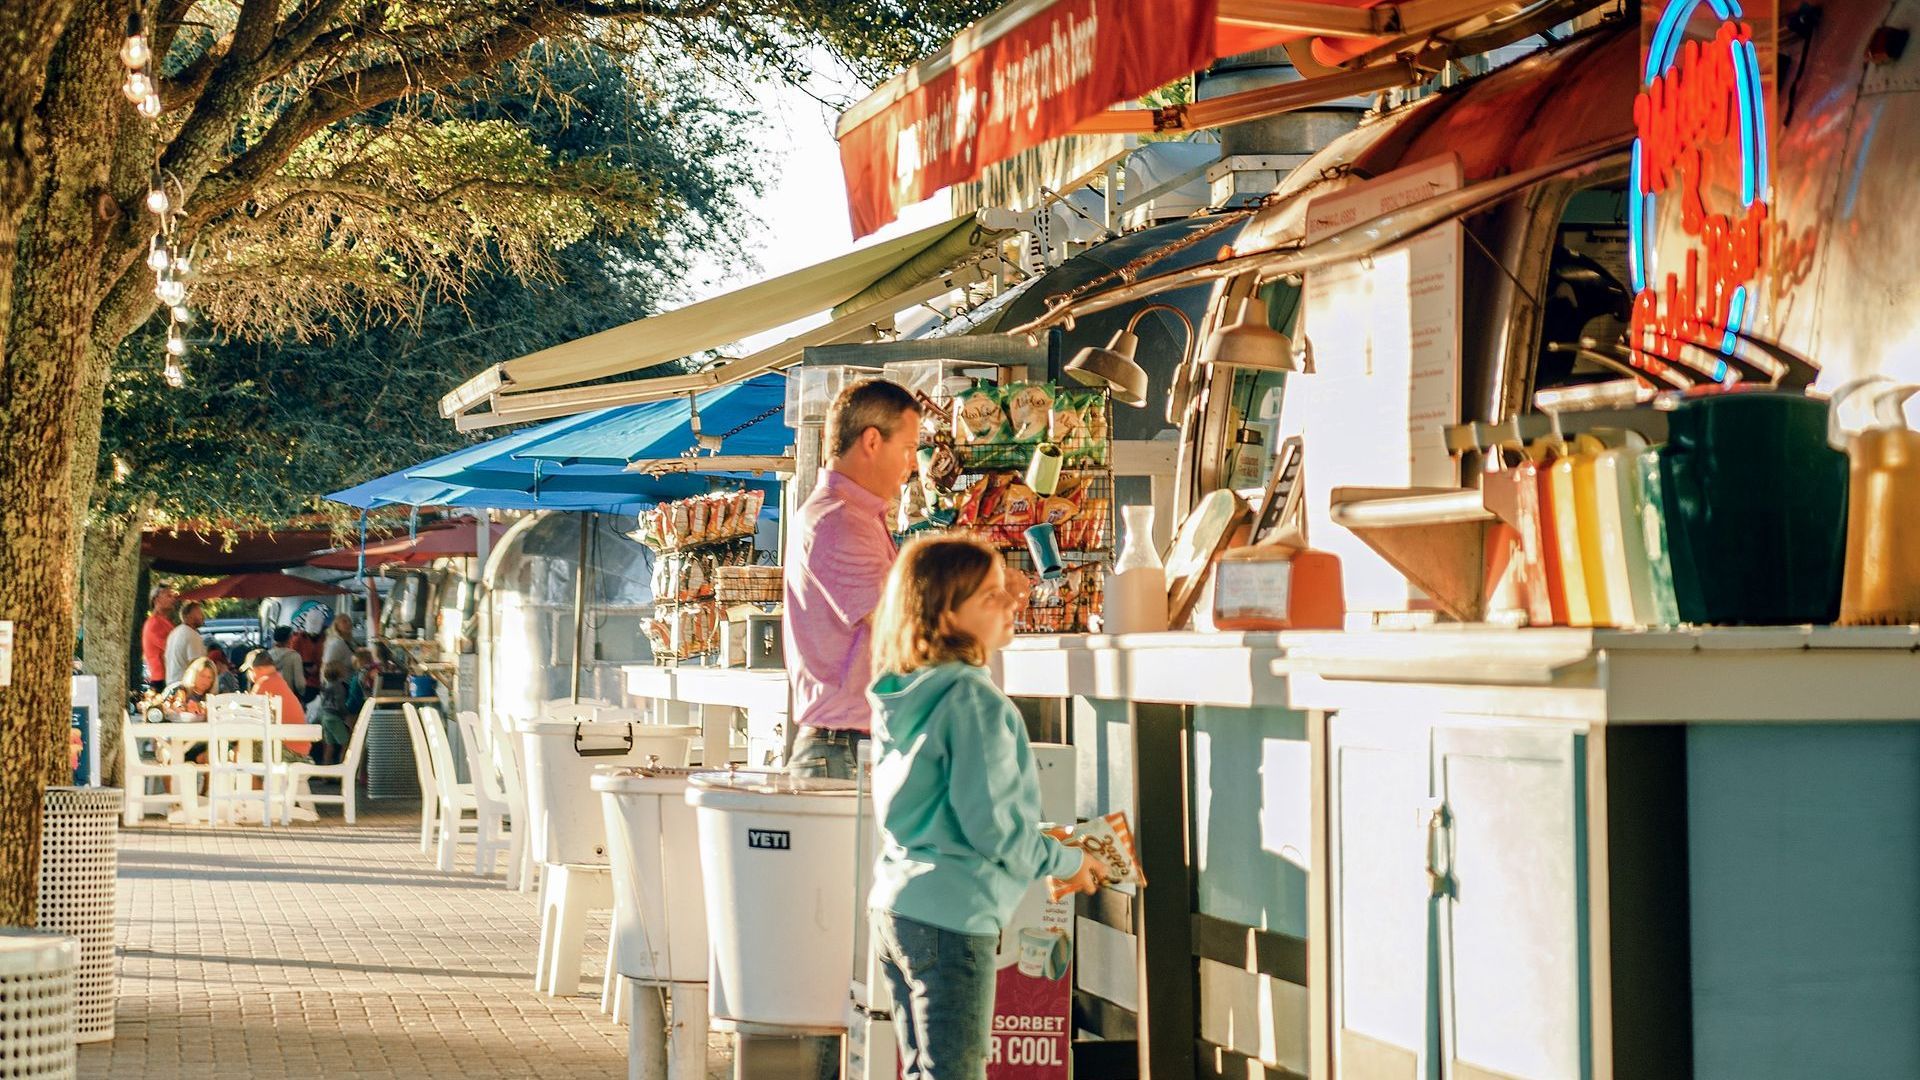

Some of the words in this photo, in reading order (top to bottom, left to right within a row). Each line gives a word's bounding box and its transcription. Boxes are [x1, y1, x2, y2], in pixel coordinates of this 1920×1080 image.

[750, 831, 788, 848] YETI
[994, 1014, 1065, 1031] SORBET
[1007, 1036, 1063, 1066] COOL
